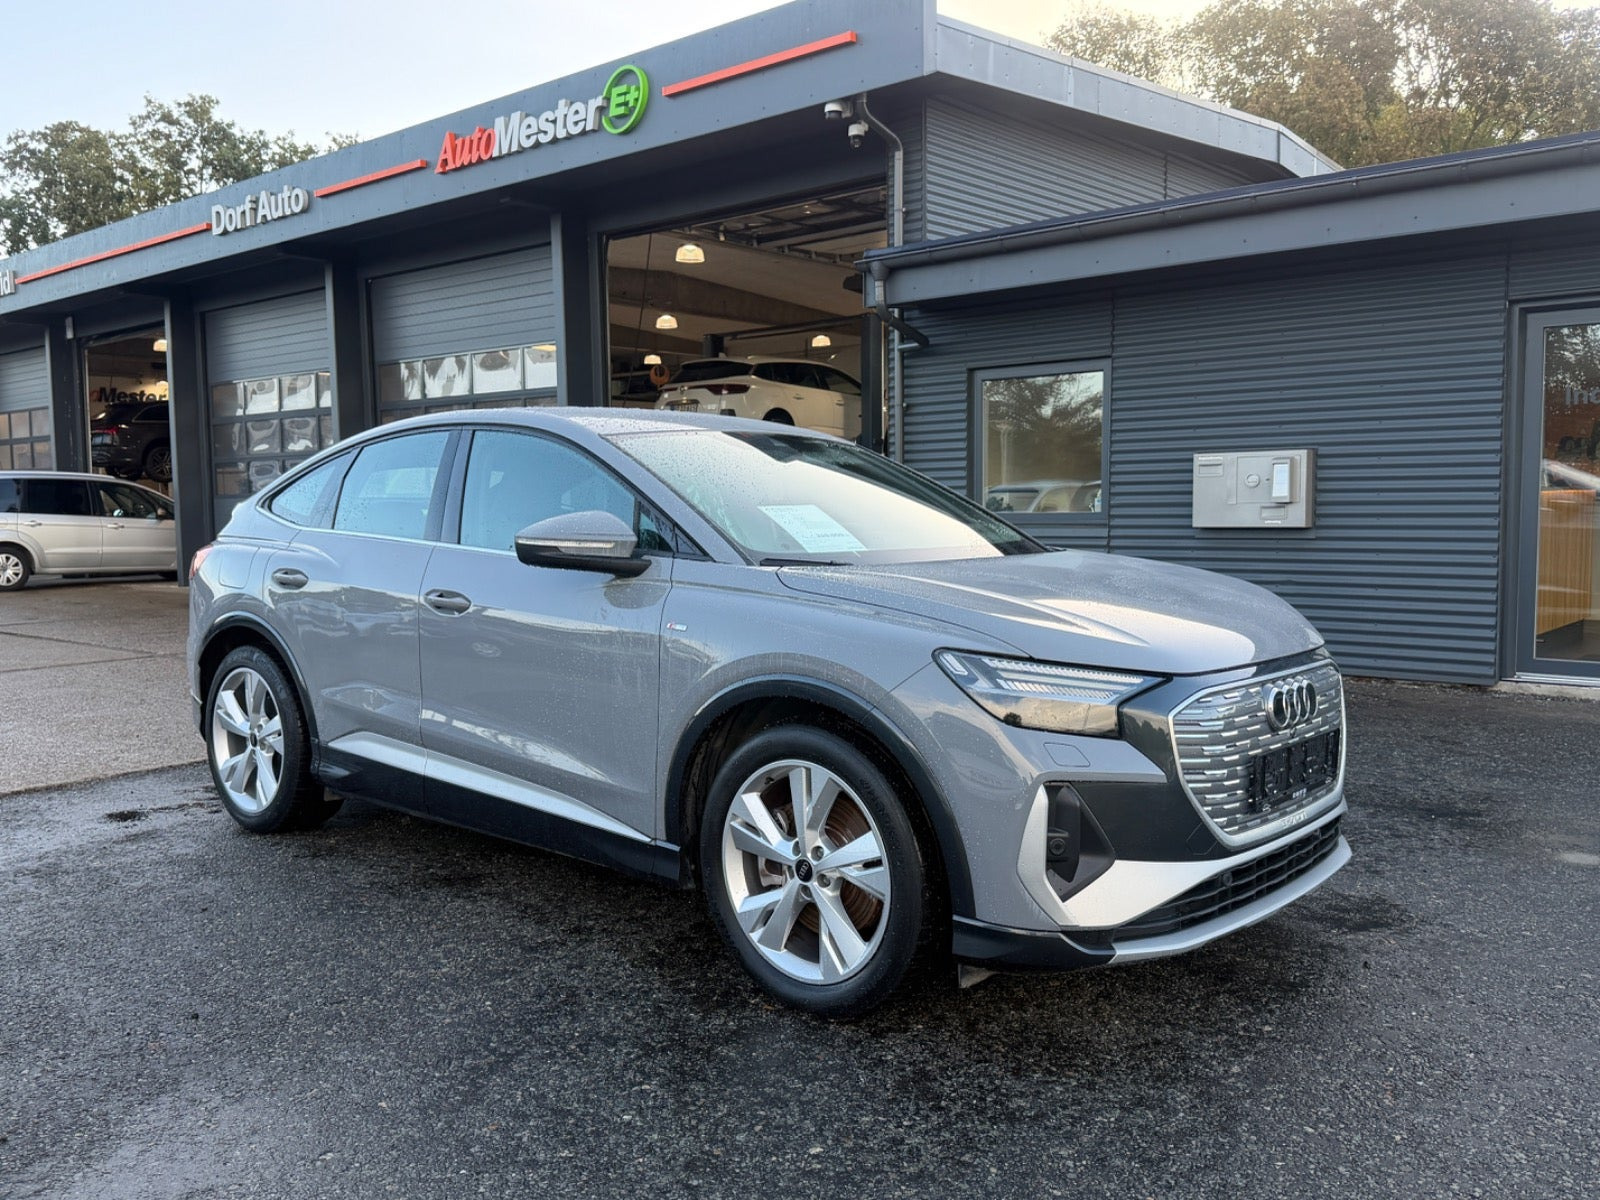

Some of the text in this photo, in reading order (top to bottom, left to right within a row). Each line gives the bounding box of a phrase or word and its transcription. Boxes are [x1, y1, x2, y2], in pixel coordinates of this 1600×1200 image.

[435, 95, 607, 174] AutoMester
[211, 185, 308, 236] Dorf Auto
